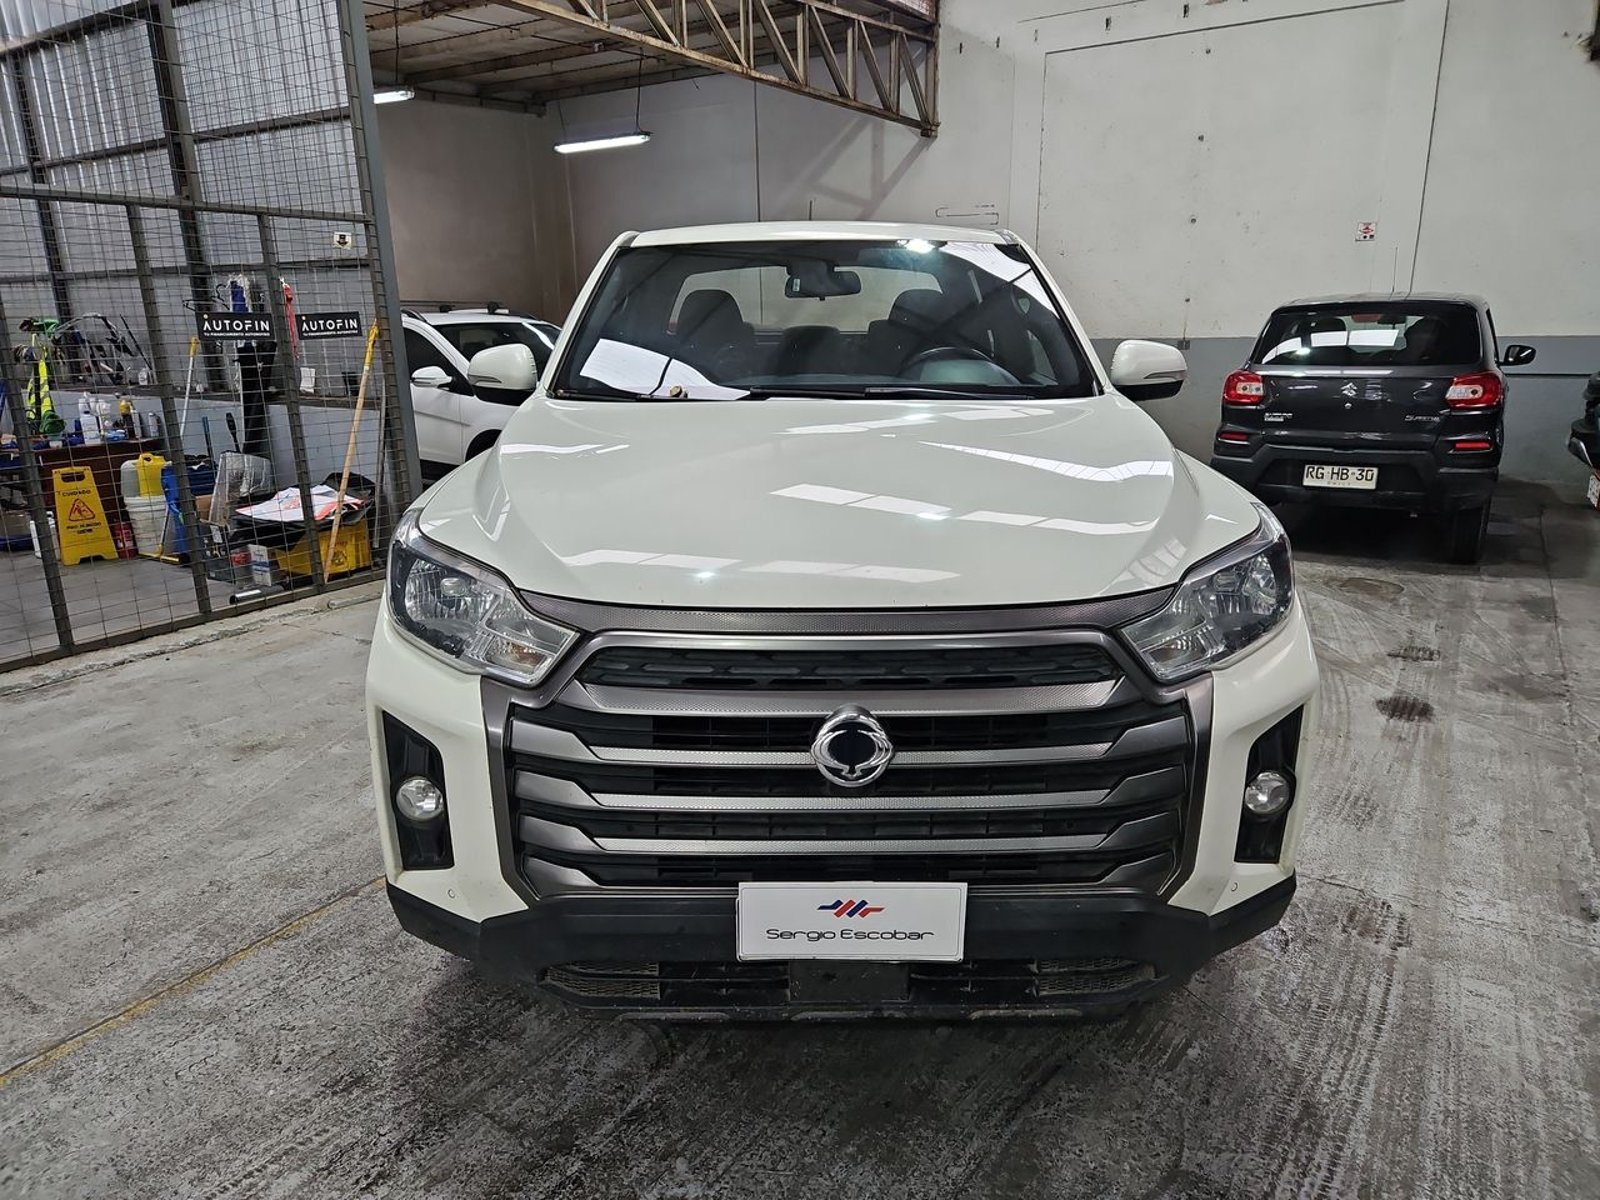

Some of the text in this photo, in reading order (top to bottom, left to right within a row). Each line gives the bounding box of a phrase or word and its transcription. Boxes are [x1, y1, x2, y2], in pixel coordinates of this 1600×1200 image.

[203, 319, 270, 331] AUTOFIN
[302, 319, 358, 331] AUTOFIN
[766, 929, 935, 942] Sergio Escobar
